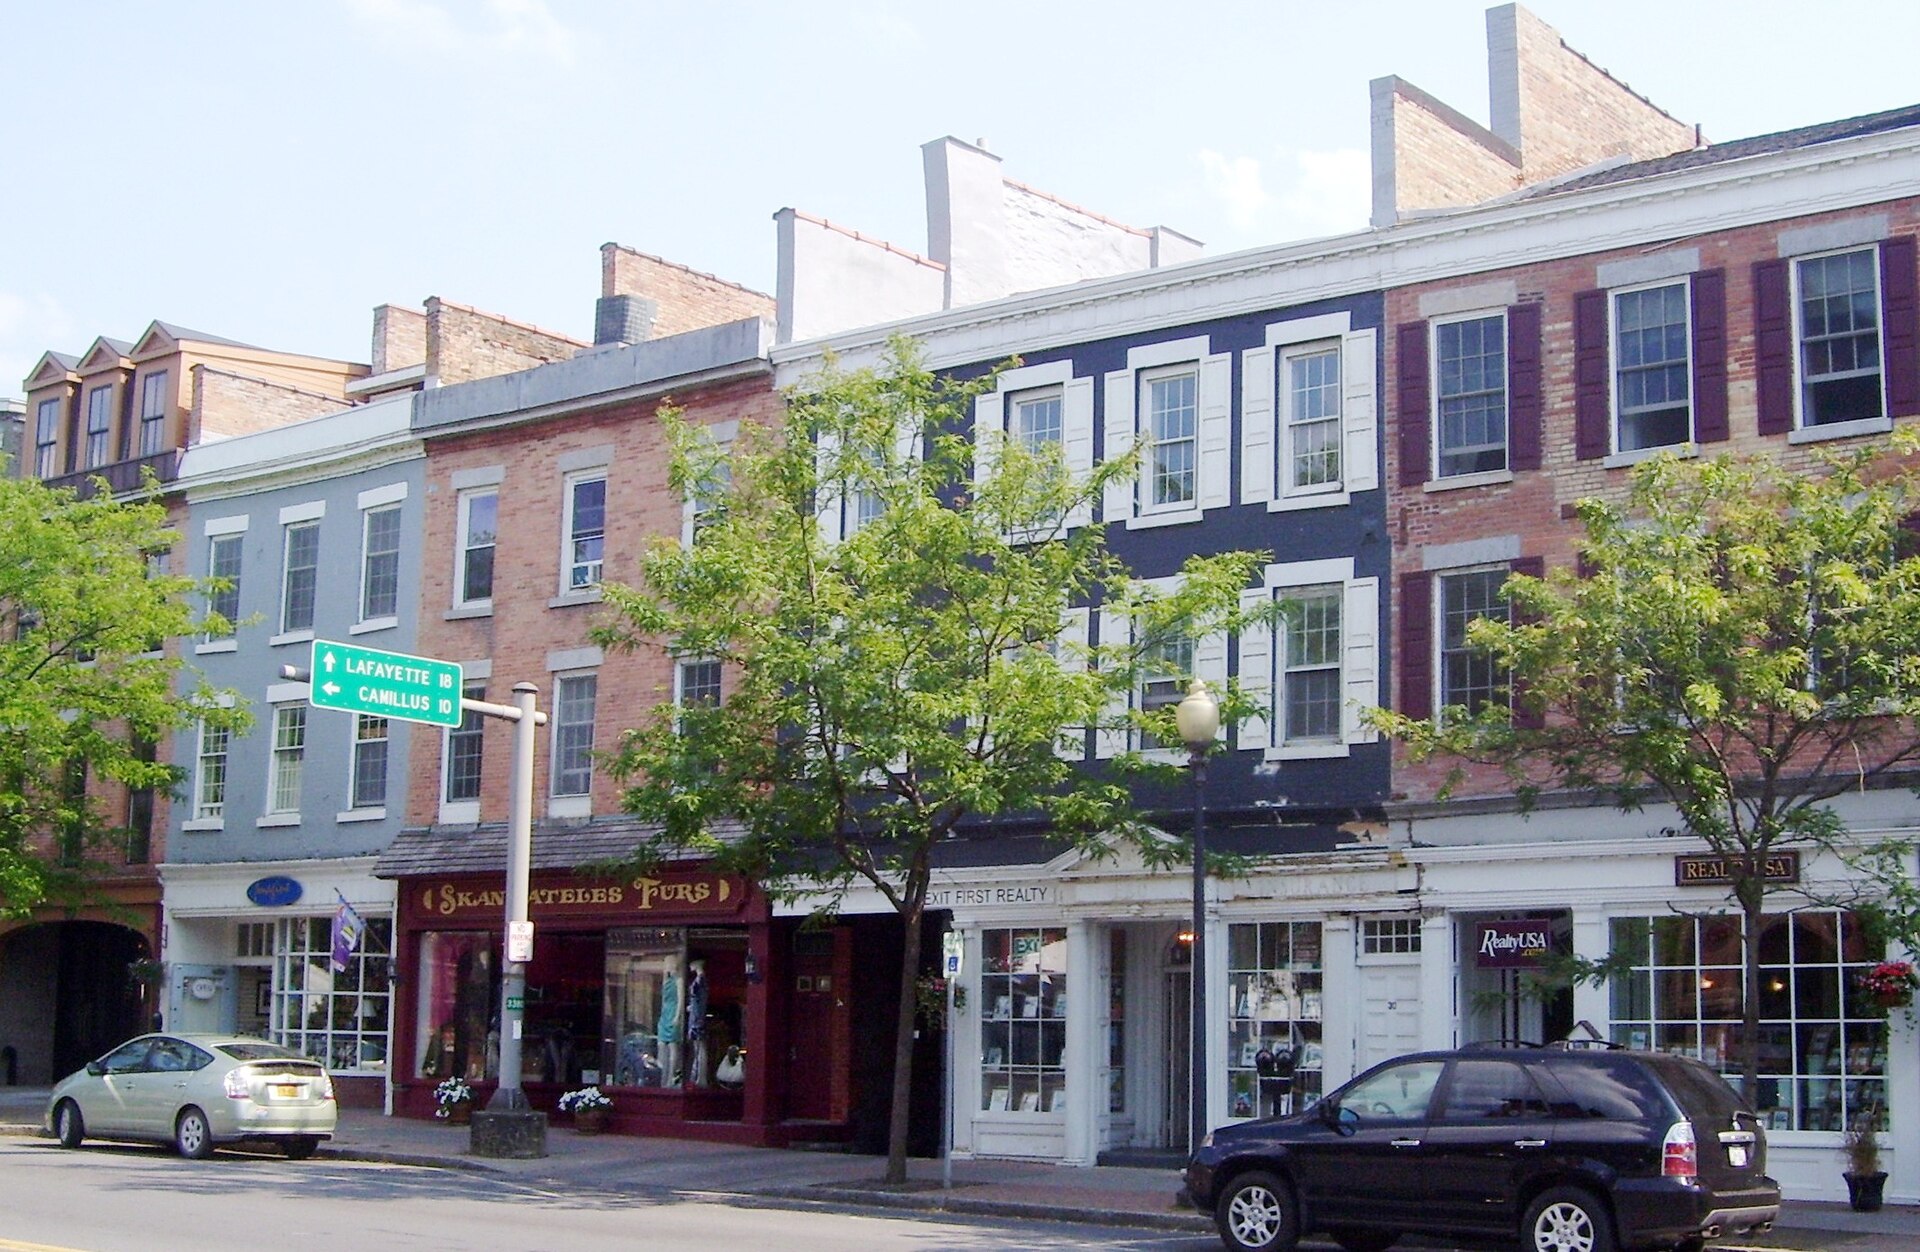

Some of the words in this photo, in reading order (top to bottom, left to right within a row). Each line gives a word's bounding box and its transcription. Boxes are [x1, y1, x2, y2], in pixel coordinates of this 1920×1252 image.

[346, 657, 430, 686] LAFAYETTE
[439, 673, 453, 689] 18
[358, 686, 430, 711] CAMILLUS
[438, 699, 452, 714] 10
[440, 884, 623, 914] SKANATELES
[633, 877, 711, 909] FURS
[925, 891, 951, 905] EXIT
[956, 890, 991, 903] FIRST
[997, 887, 1047, 902] REALTY
[1479, 929, 1547, 957] RealtyUSA
